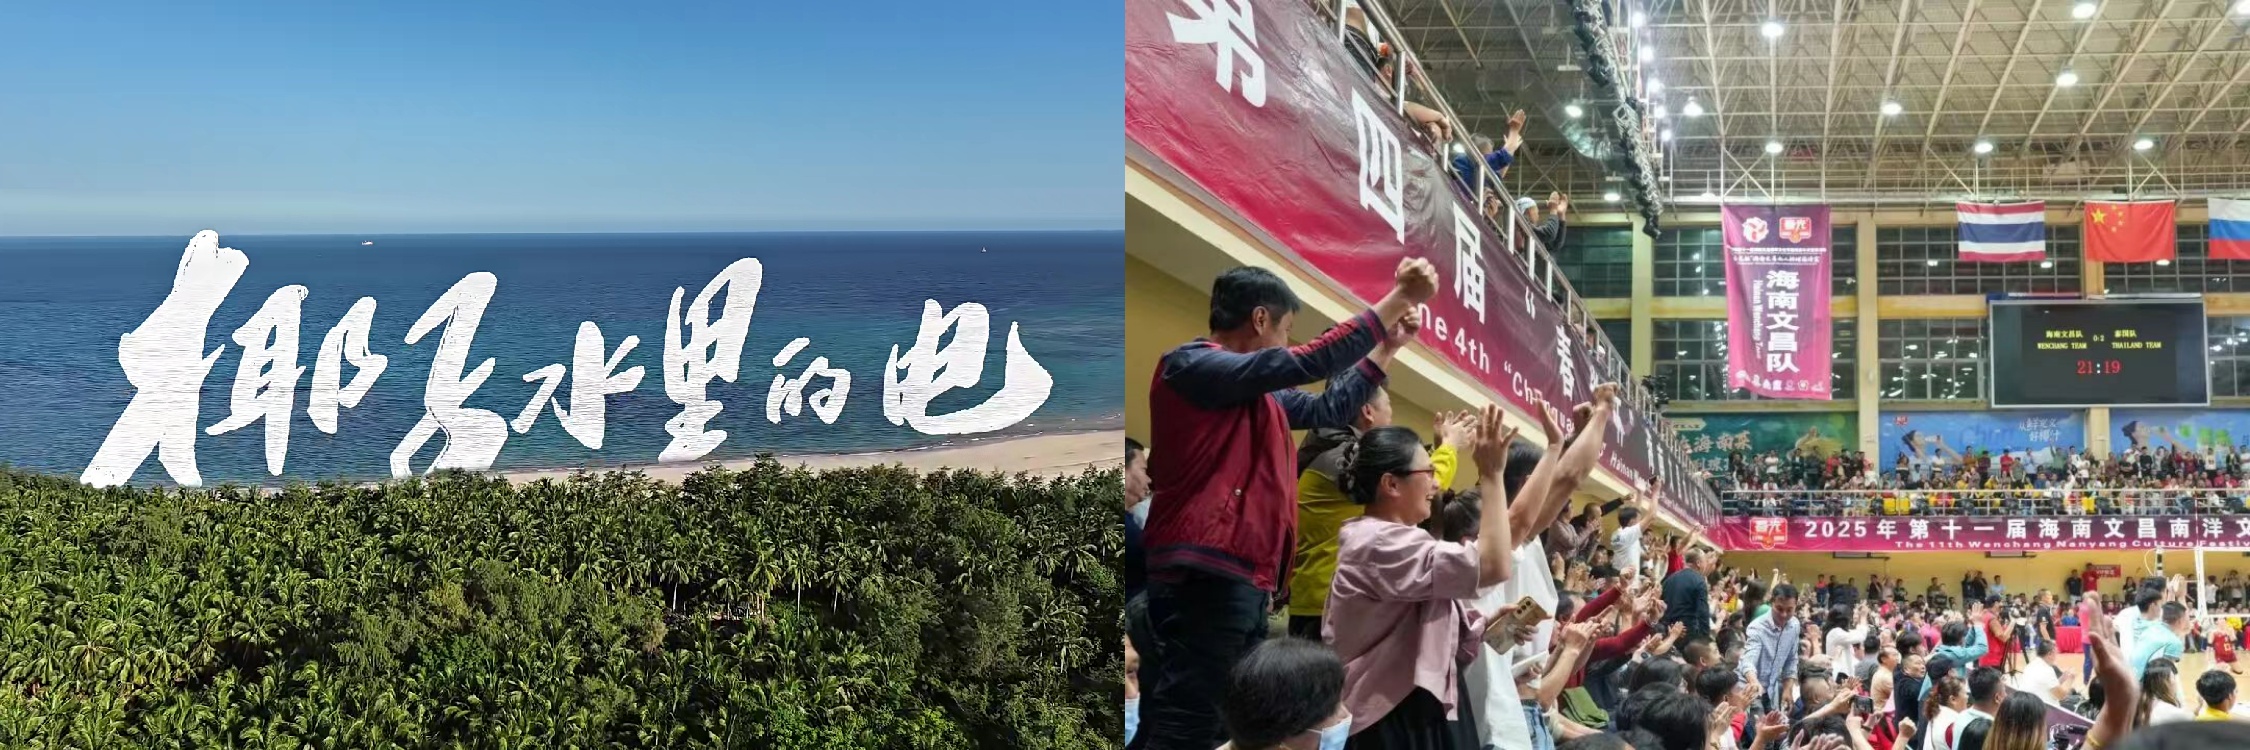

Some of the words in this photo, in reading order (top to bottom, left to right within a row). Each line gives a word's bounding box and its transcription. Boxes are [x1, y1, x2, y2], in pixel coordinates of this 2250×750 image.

[1765, 270, 1800, 373] 海南文昌队
[2045, 330, 2083, 338] 海南文昌队
[1454, 327, 1490, 374] 4th
[2146, 341, 2162, 349] TEAM
[2077, 360, 2121, 374] 21:19
[1968, 541, 2050, 549] Wenchang
[2056, 541, 2127, 549] Nanyang
